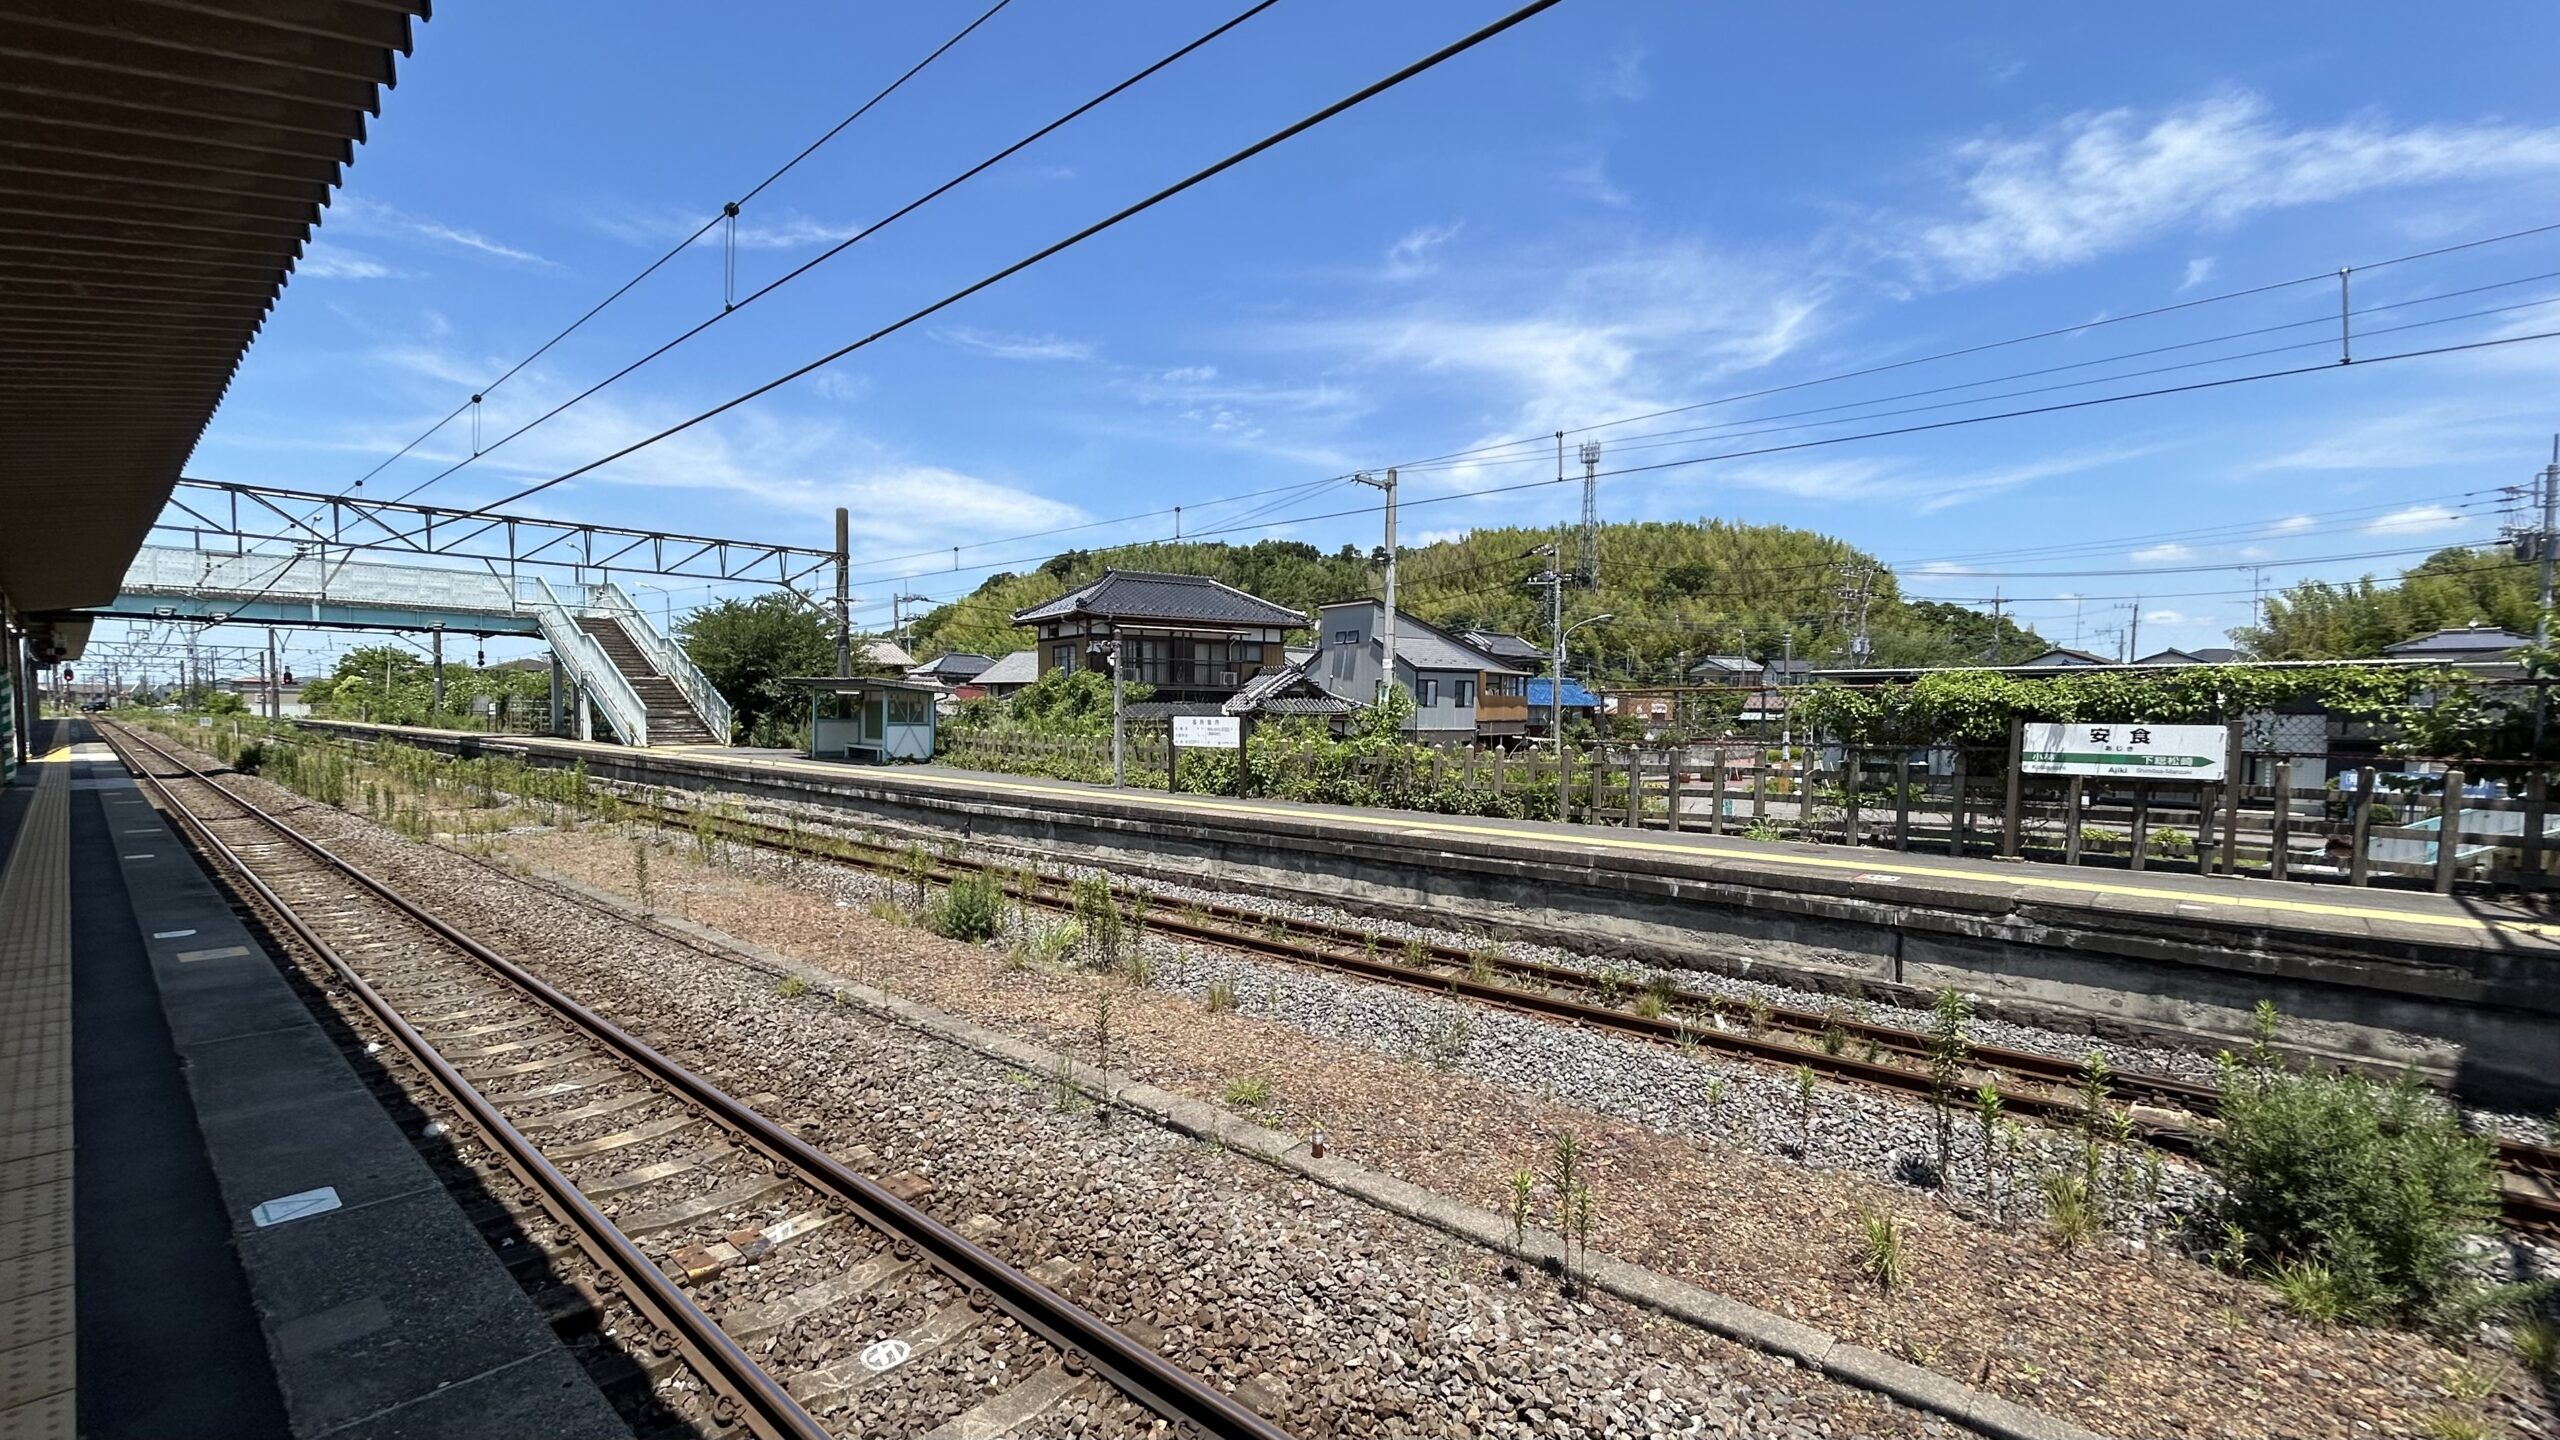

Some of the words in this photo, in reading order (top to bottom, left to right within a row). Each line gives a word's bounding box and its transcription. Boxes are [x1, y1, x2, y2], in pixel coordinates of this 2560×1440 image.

[2090, 728, 2151, 744] 安食
[2142, 756, 2194, 766] 下総松崎
[2108, 766, 2128, 774] Ajiki
